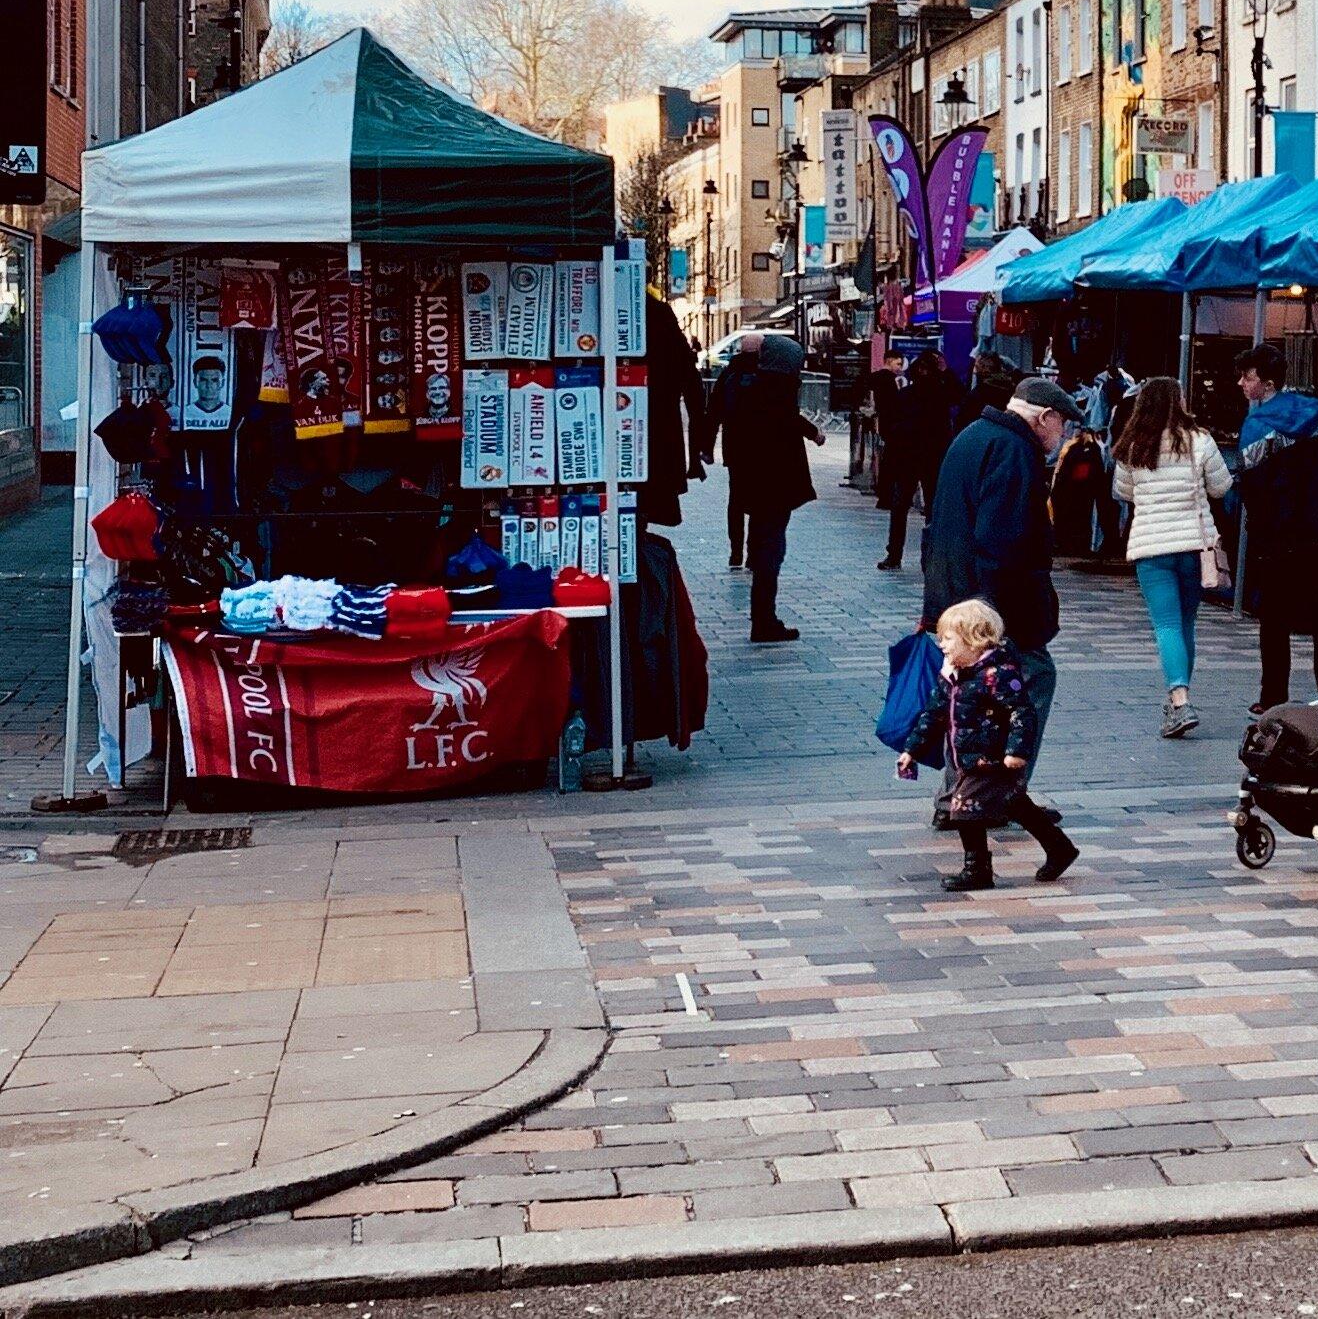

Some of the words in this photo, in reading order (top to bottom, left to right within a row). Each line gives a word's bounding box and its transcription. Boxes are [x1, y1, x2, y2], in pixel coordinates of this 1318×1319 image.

[1139, 118, 1189, 132] RECORD
[831, 132, 849, 224] tattoo
[947, 134, 972, 208] BUBBLE
[1174, 173, 1197, 189] OFF
[571, 267, 583, 314] TRAFFORD
[585, 266, 597, 285] OLD
[186, 282, 196, 334] ENGLAND
[195, 280, 224, 352] ALLI
[289, 288, 325, 369] VAN
[522, 295, 537, 357] STADIUM
[617, 308, 629, 327] N17
[414, 294, 424, 374] MANAGER
[426, 295, 450, 375] KLOPP
[468, 310, 481, 353] LONDON
[481, 313, 494, 353] STADIUM
[507, 304, 522, 356] ETIHAD
[617, 328, 629, 352] LANE
[463, 408, 475, 433] Real
[480, 394, 498, 454] STADIUM
[530, 393, 545, 441] ANFIELD
[572, 421, 584, 439] SW6
[621, 418, 633, 432] N5
[463, 434, 475, 469] Madrid
[530, 444, 544, 460] L4
[561, 430, 575, 480] STAMFORD
[574, 441, 587, 479] BRIDGE
[620, 435, 633, 478] STADIUM
[246, 730, 277, 774] FC
[405, 730, 495, 771] L.F.C.
